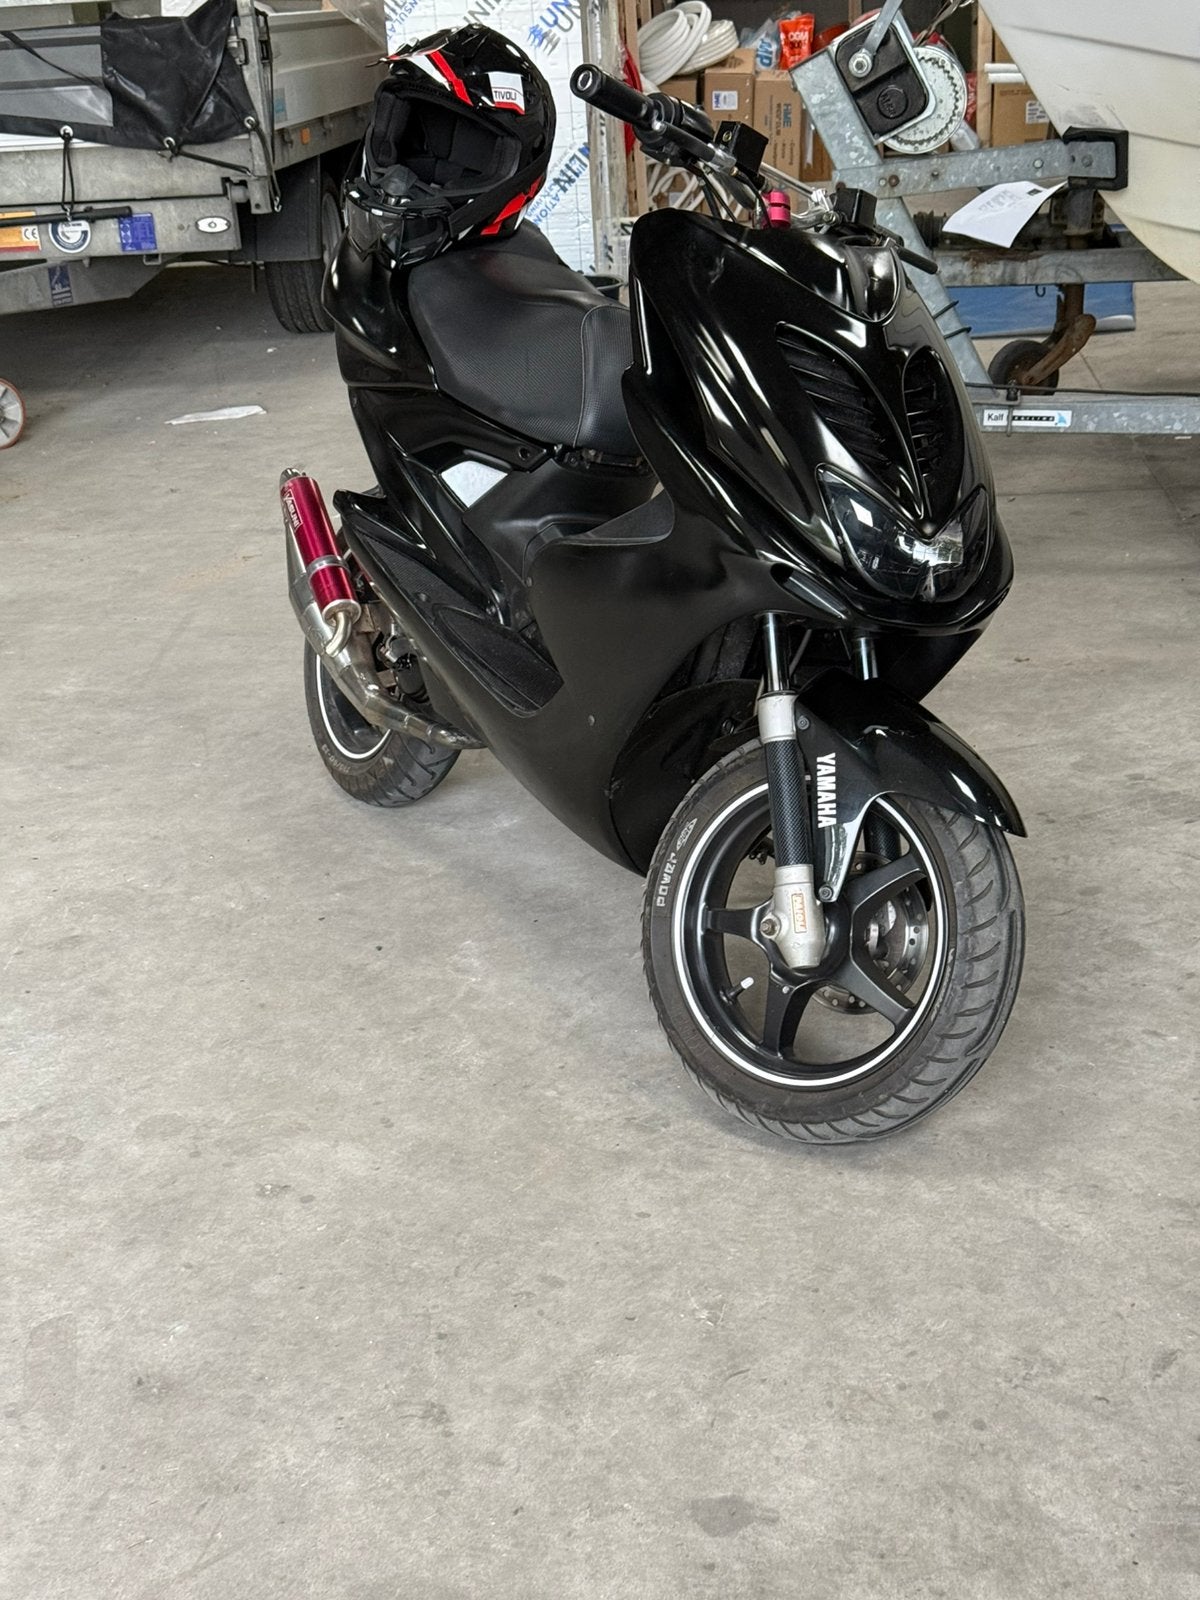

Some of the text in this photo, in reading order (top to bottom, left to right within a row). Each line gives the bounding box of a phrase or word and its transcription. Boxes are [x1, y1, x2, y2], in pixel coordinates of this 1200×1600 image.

[493, 90, 517, 101] TIVOLI
[987, 412, 1004, 421] Kalf
[816, 752, 837, 829] YAMAHA
